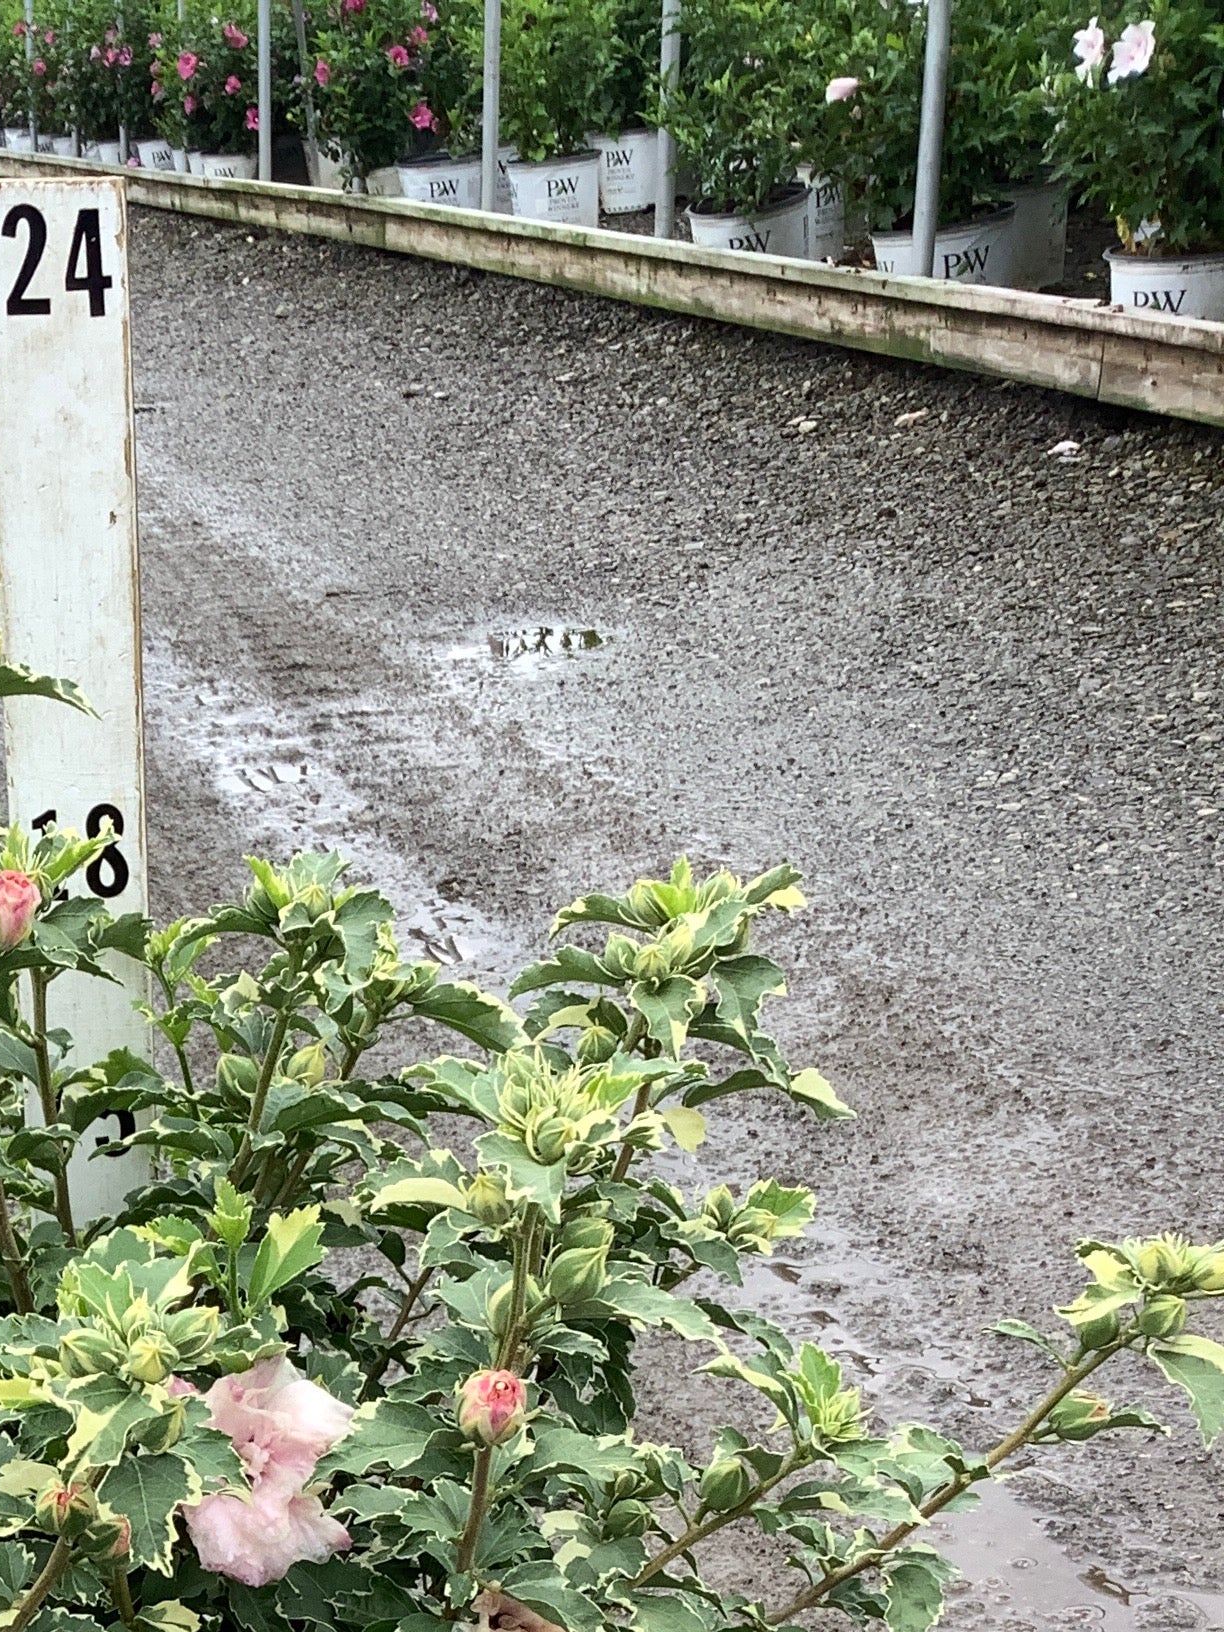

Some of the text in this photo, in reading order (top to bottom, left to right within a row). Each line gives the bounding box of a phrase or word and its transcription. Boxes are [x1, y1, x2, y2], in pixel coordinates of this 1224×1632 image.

[606, 149, 633, 167] PW
[429, 179, 460, 198] PW
[547, 176, 579, 197] PW
[1, 204, 112, 317] 24
[942, 244, 989, 279] PW
